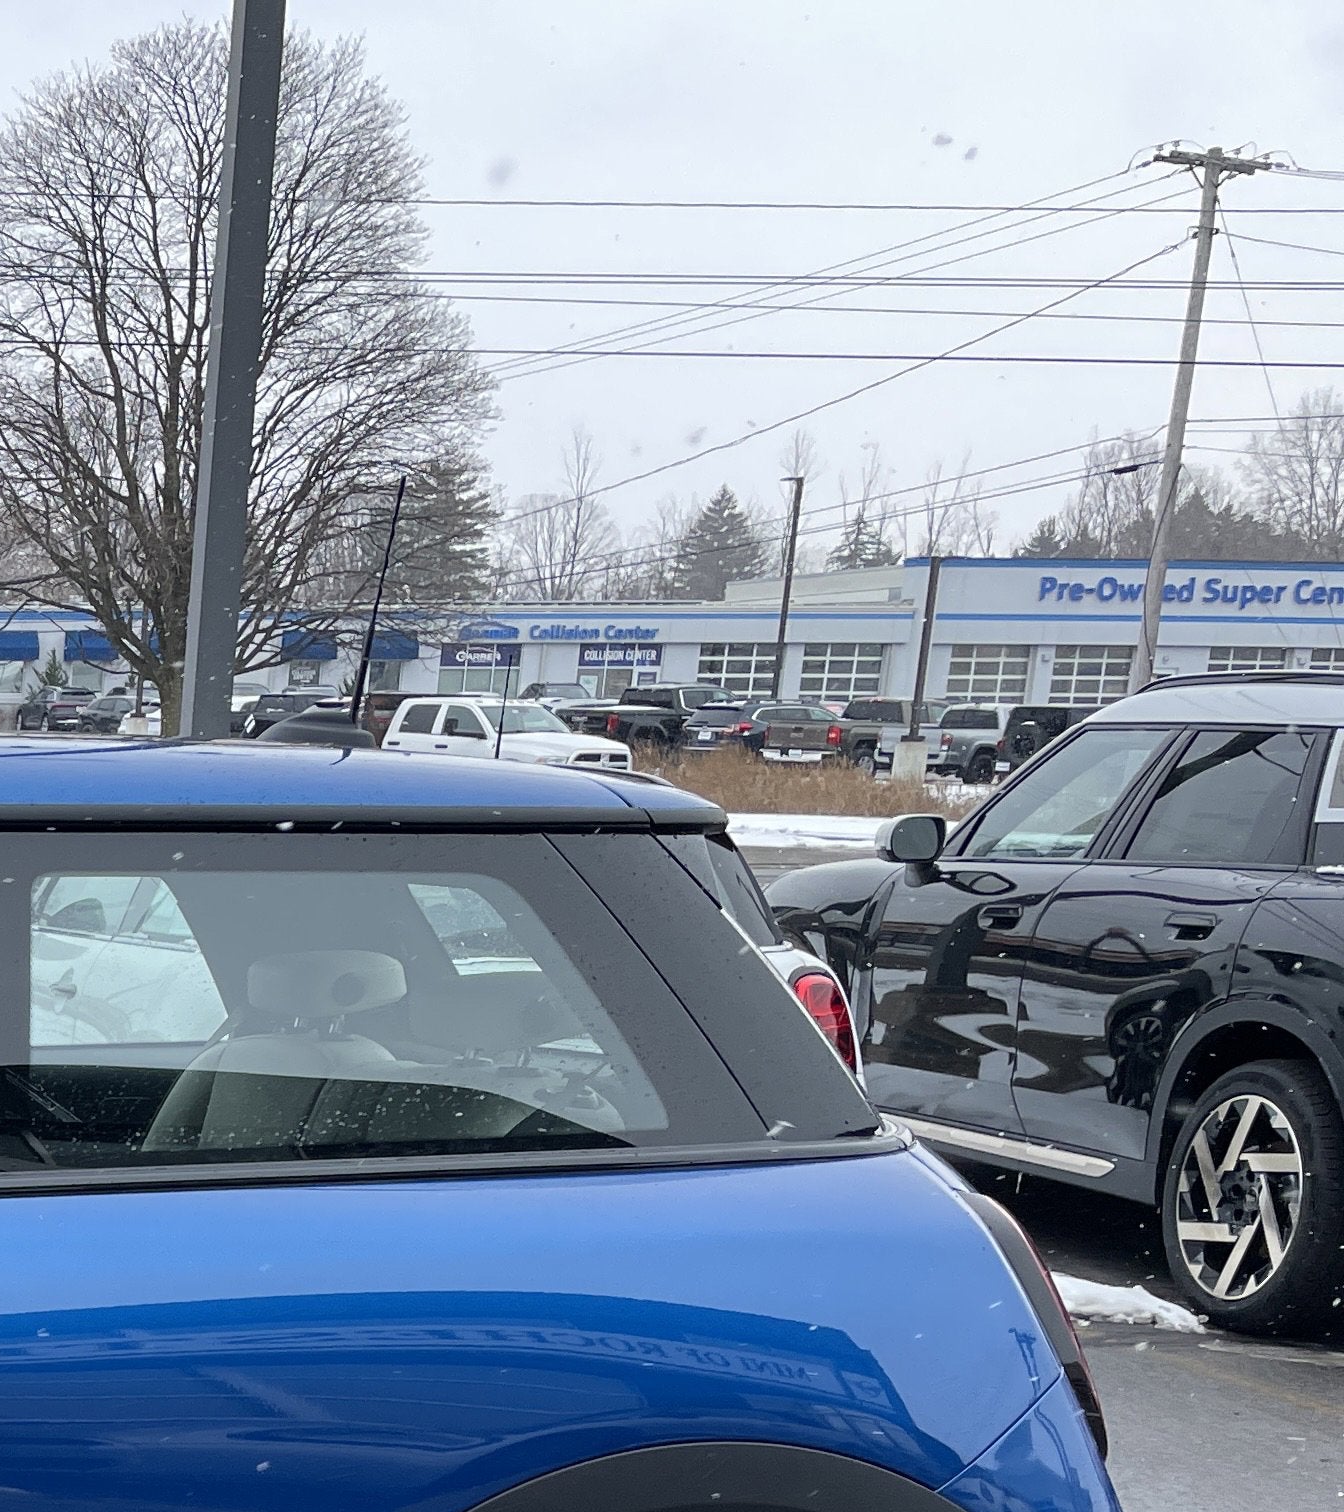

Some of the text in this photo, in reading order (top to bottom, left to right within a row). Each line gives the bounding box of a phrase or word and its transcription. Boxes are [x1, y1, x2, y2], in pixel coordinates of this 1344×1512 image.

[1039, 576, 1344, 610] Pre-Owed Super Cen
[529, 624, 601, 641] Collision
[604, 624, 659, 641] Center
[584, 648, 657, 661] COLLISION CENTER
